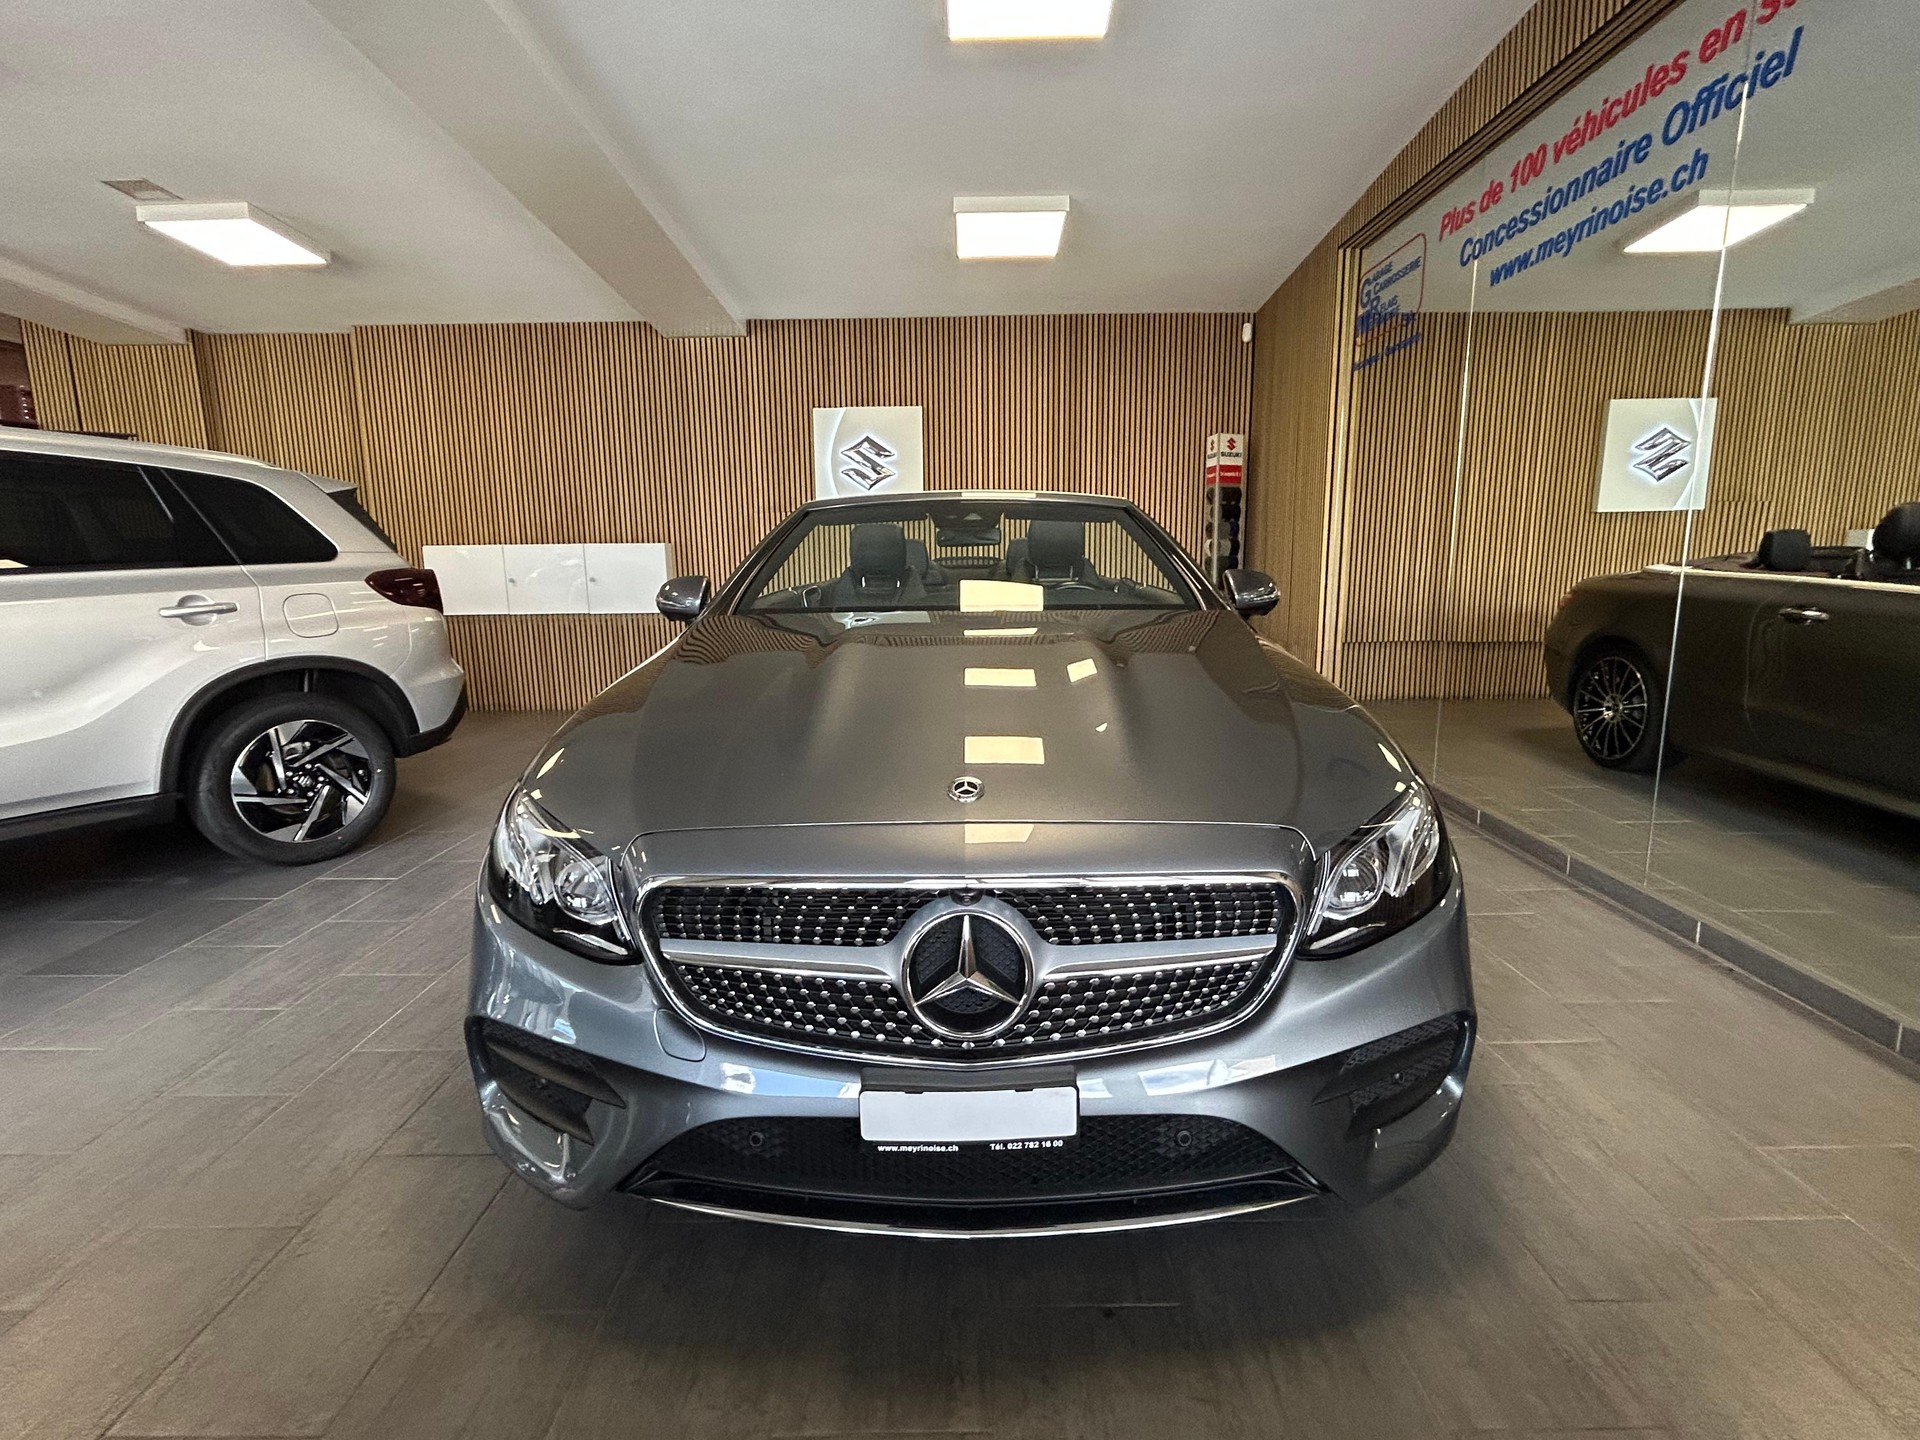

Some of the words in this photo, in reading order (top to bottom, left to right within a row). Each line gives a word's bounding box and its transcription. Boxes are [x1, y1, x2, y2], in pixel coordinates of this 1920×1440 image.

[1439, 202, 1475, 242] Plus
[1478, 179, 1504, 214] de
[1510, 143, 1549, 194] 100
[1553, 50, 1690, 165] véhicules
[1698, 8, 1748, 64] en
[1459, 131, 1653, 268] Concessionnaire
[1662, 25, 1805, 146] Officiel
[1489, 148, 1710, 287] www.meyrinoise.ch
[877, 1144, 959, 1153] www.meyrinoise.ch
[990, 1143, 1005, 1151] Tél.
[1007, 1142, 1023, 1150] 022
[1024, 1141, 1039, 1149] 782
[1052, 1140, 1064, 1148] 00
